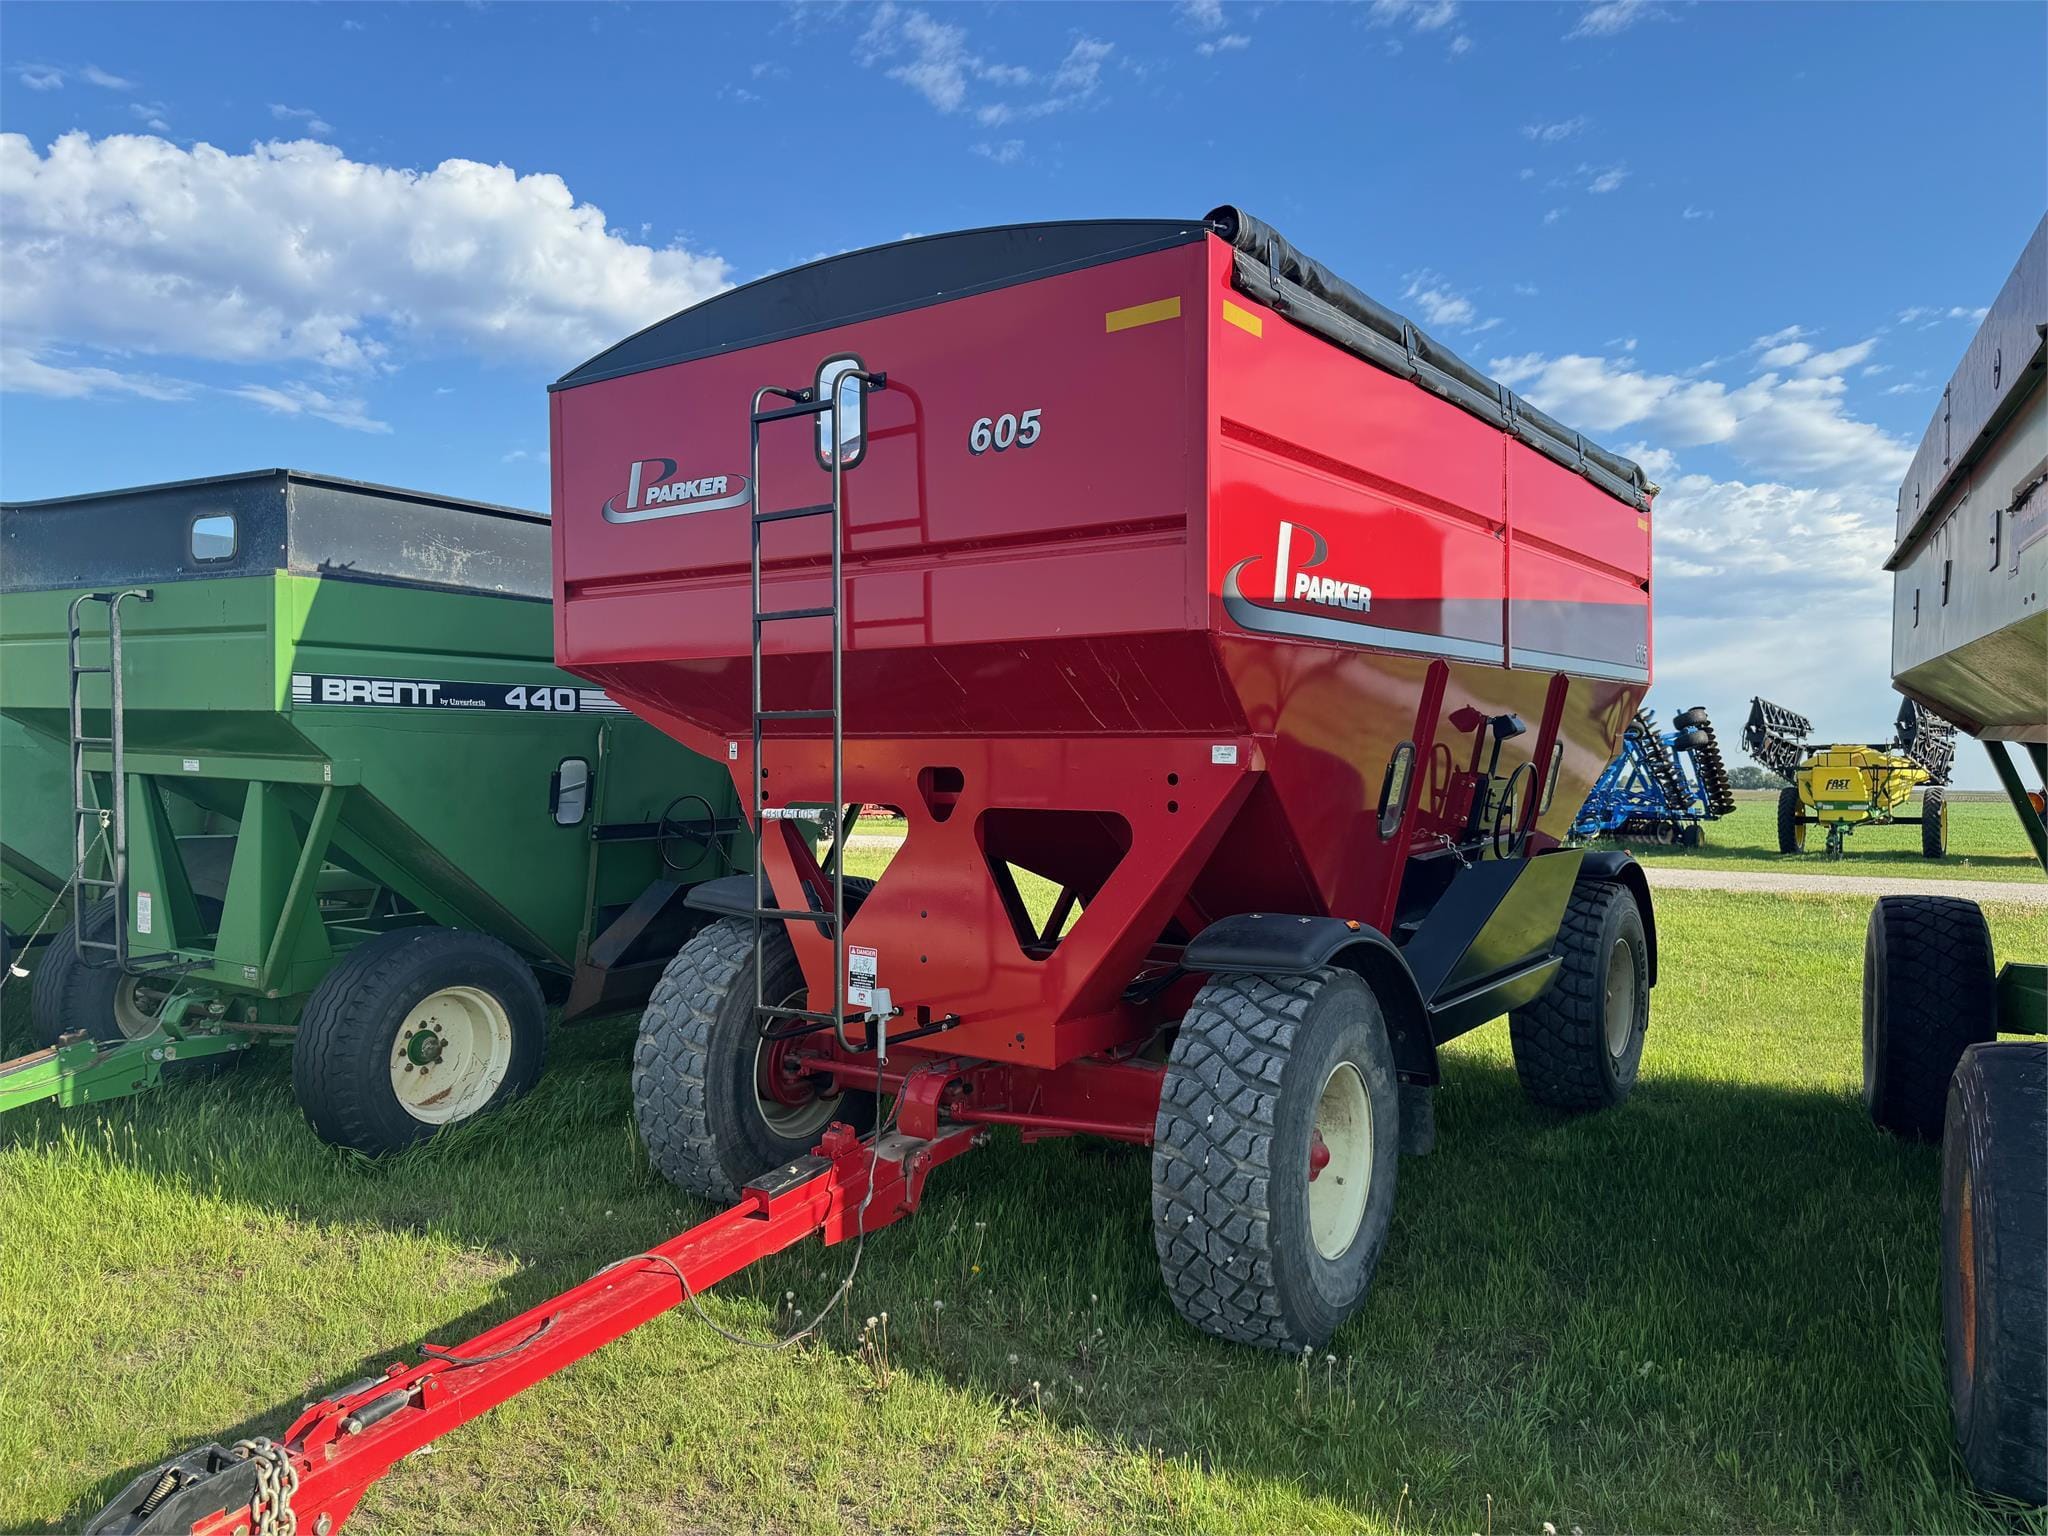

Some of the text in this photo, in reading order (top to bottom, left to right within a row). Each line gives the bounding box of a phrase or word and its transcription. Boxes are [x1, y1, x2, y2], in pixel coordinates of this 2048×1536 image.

[968, 408, 1042, 456] 605
[645, 474, 728, 505] PARKER
[1293, 572, 1372, 613] PARKER
[322, 678, 576, 712] BRENT by Unverferth 440
[1825, 778, 1851, 791] FAST
[856, 948, 876, 957] DANGER
